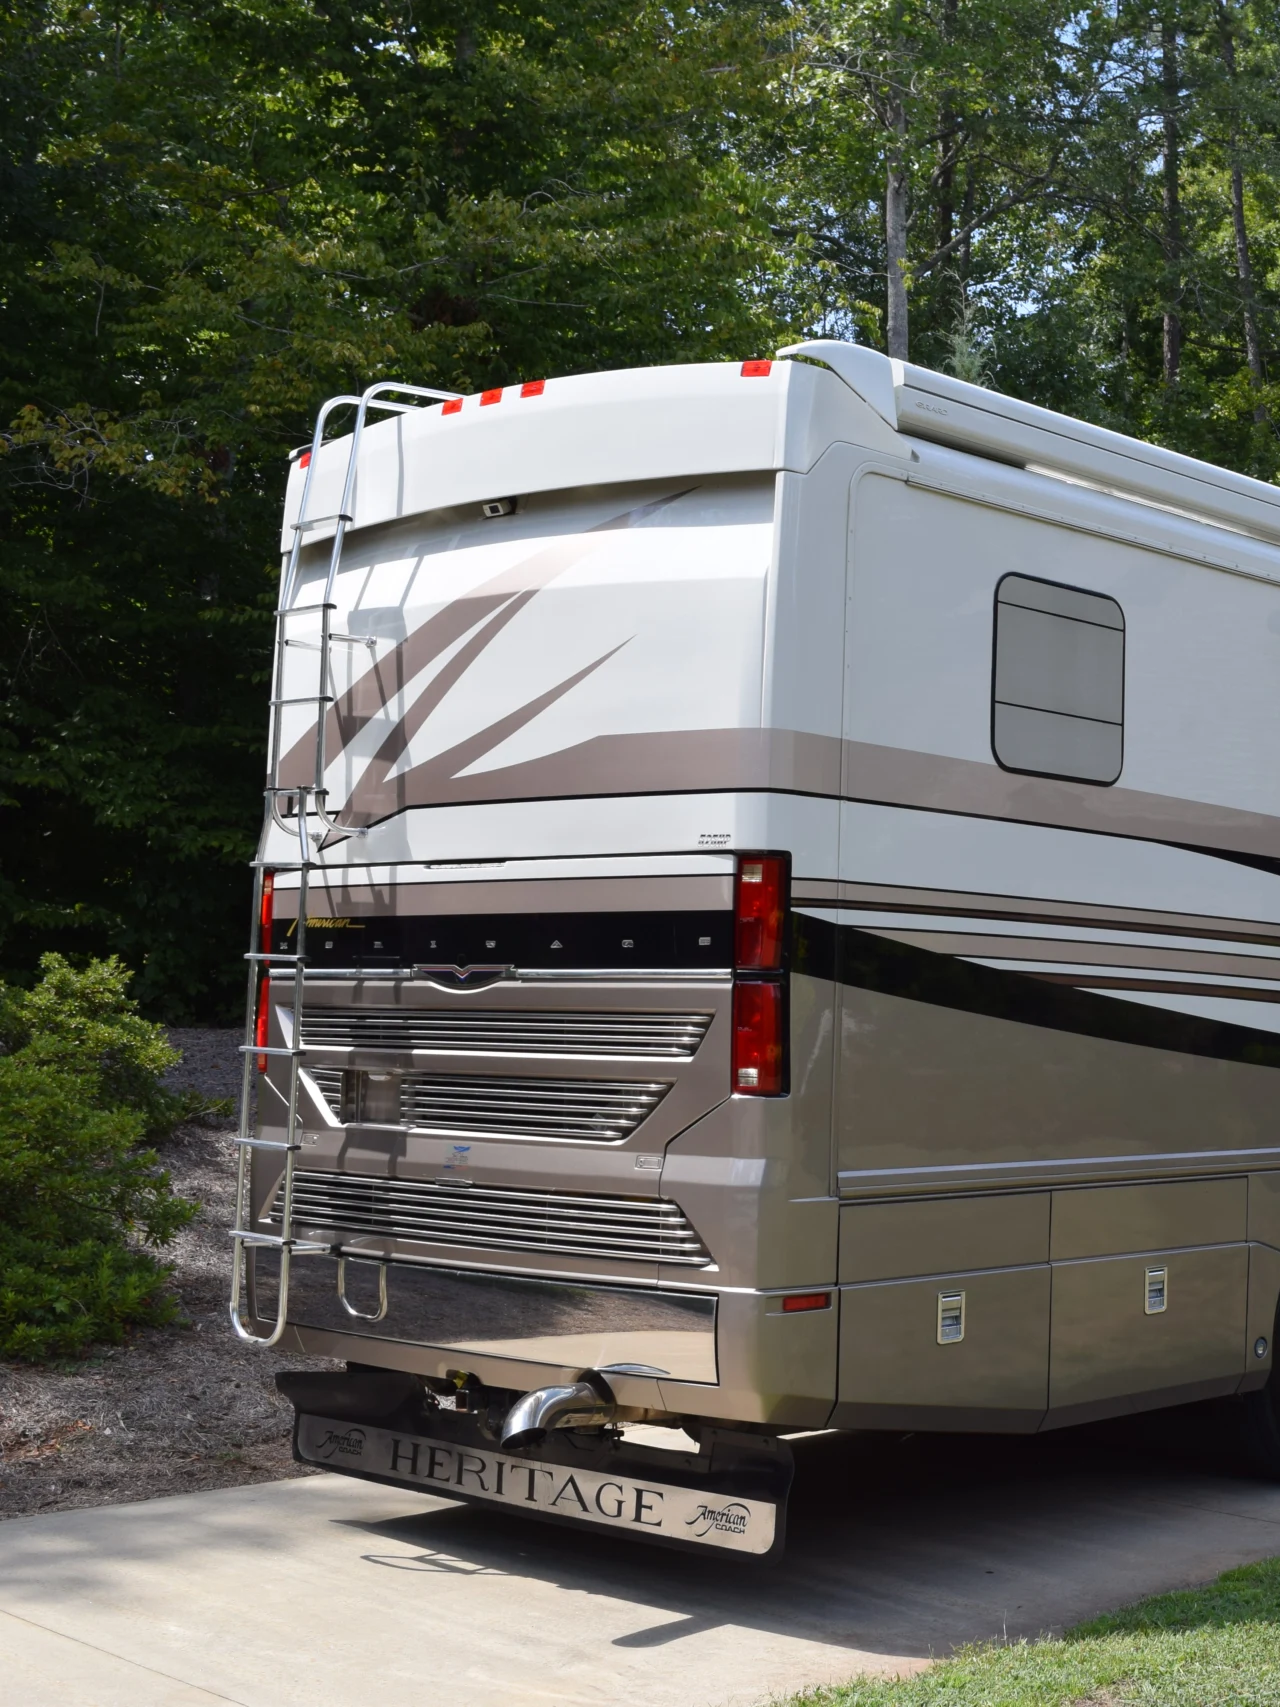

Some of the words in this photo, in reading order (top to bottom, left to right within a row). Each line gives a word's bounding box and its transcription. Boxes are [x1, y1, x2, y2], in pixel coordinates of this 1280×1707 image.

[315, 1430, 365, 1450] American
[338, 1446, 363, 1457] COACH
[389, 1438, 664, 1528] HERITAGE
[684, 1504, 748, 1528] American
[714, 1522, 747, 1535] COACH
